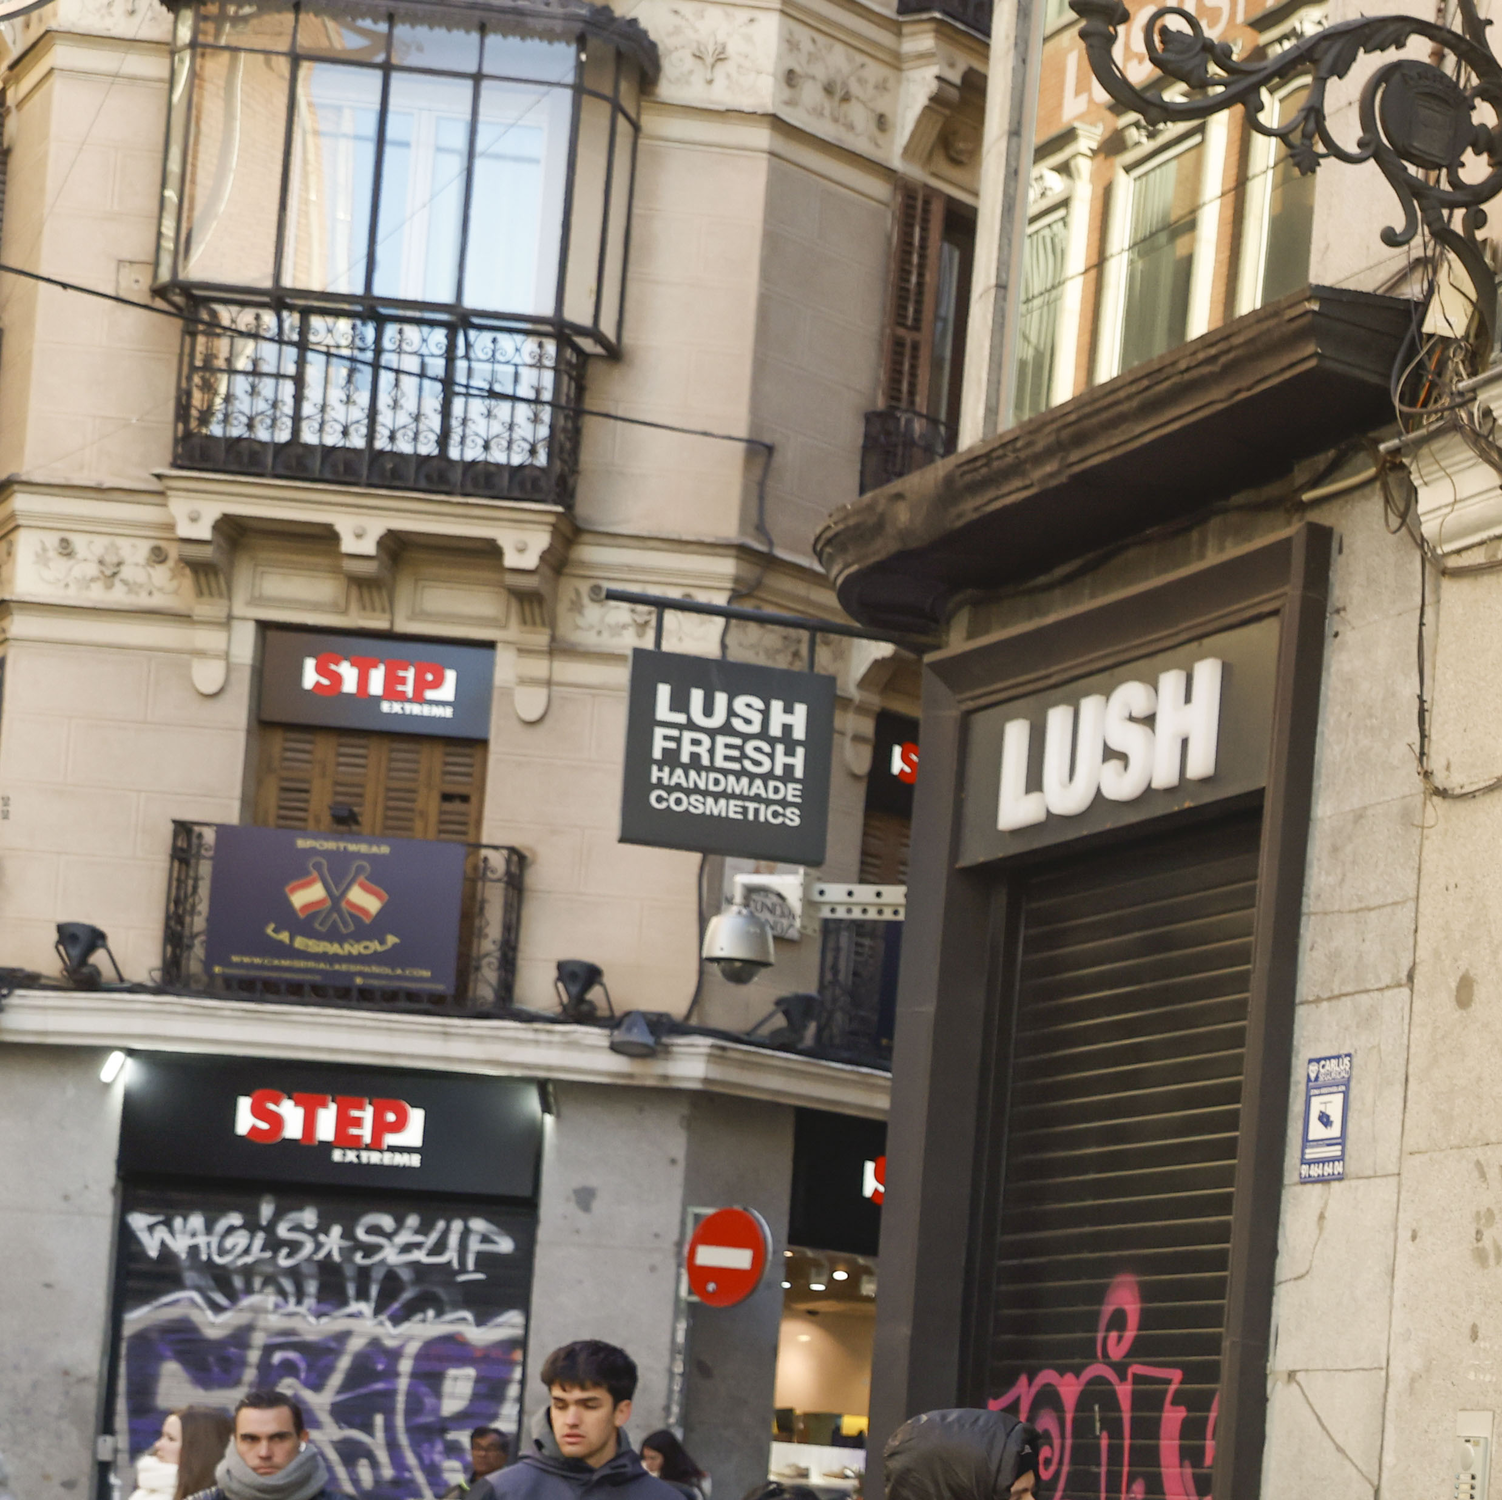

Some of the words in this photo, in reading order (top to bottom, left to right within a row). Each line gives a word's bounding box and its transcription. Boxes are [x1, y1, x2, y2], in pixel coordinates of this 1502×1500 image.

[309, 651, 448, 703] STEP
[380, 700, 454, 718] EXTREME
[655, 682, 808, 741] LUSH
[652, 726, 806, 779] FRESH
[997, 657, 1223, 832] LUSH
[650, 764, 803, 803] HANDMADE
[649, 789, 801, 827] COSMETICS
[296, 838, 391, 855] SPORTWEAR
[265, 922, 290, 945] LA
[294, 933, 400, 956] ESPAÑOLA
[244, 1088, 413, 1150] STEP
[332, 1148, 422, 1168] EXTREME
